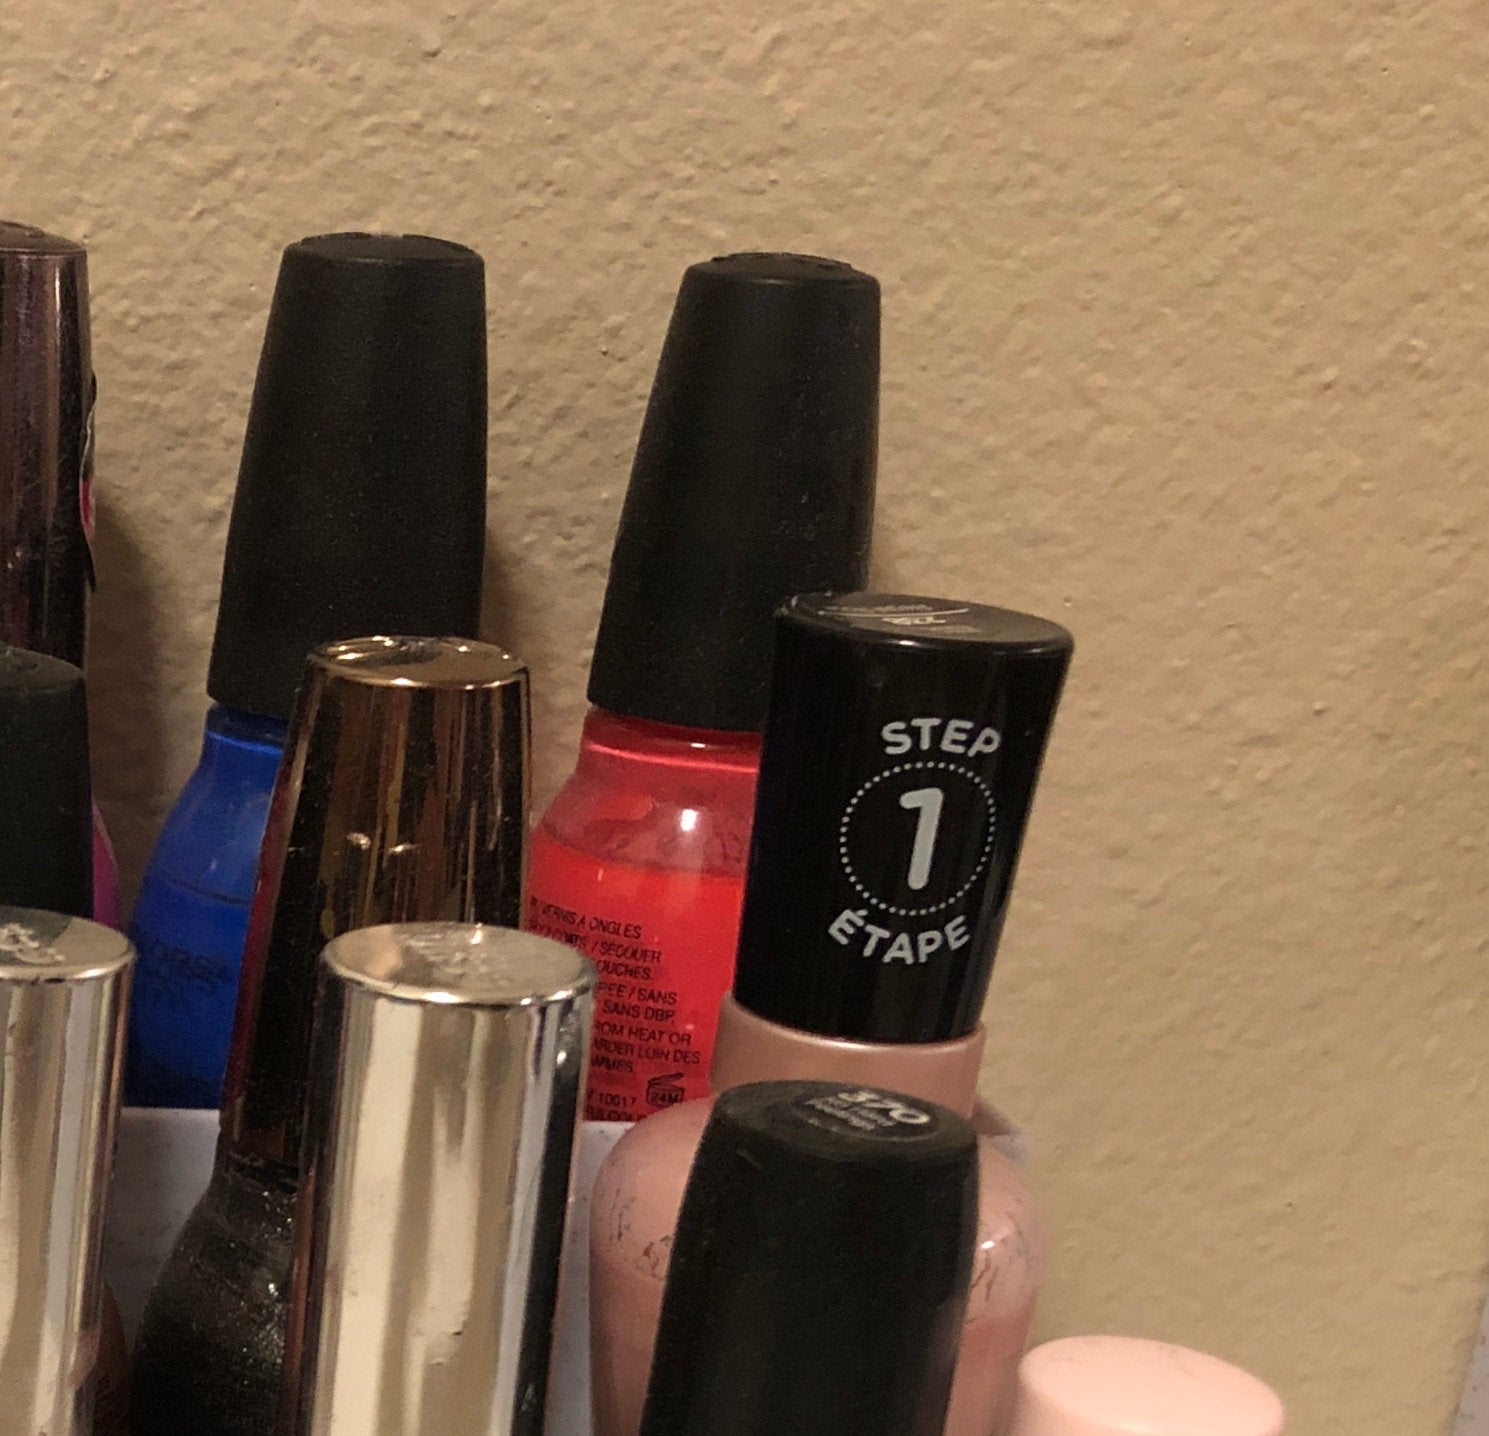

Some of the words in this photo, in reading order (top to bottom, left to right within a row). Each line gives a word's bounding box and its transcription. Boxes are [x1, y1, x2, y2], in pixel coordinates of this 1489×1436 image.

[880, 717, 1001, 758] STEP
[899, 787, 944, 890] 1
[589, 916, 642, 940] ONGLES
[828, 908, 972, 966] ÉTAPE
[597, 958, 654, 981] OUCHES.
[637, 986, 678, 1006] SANS
[603, 1000, 641, 1019] SANS
[594, 1020, 624, 1037] ROM
[628, 1026, 665, 1042] HEAT
[668, 1031, 692, 1047] OR
[673, 1049, 700, 1066] DES
